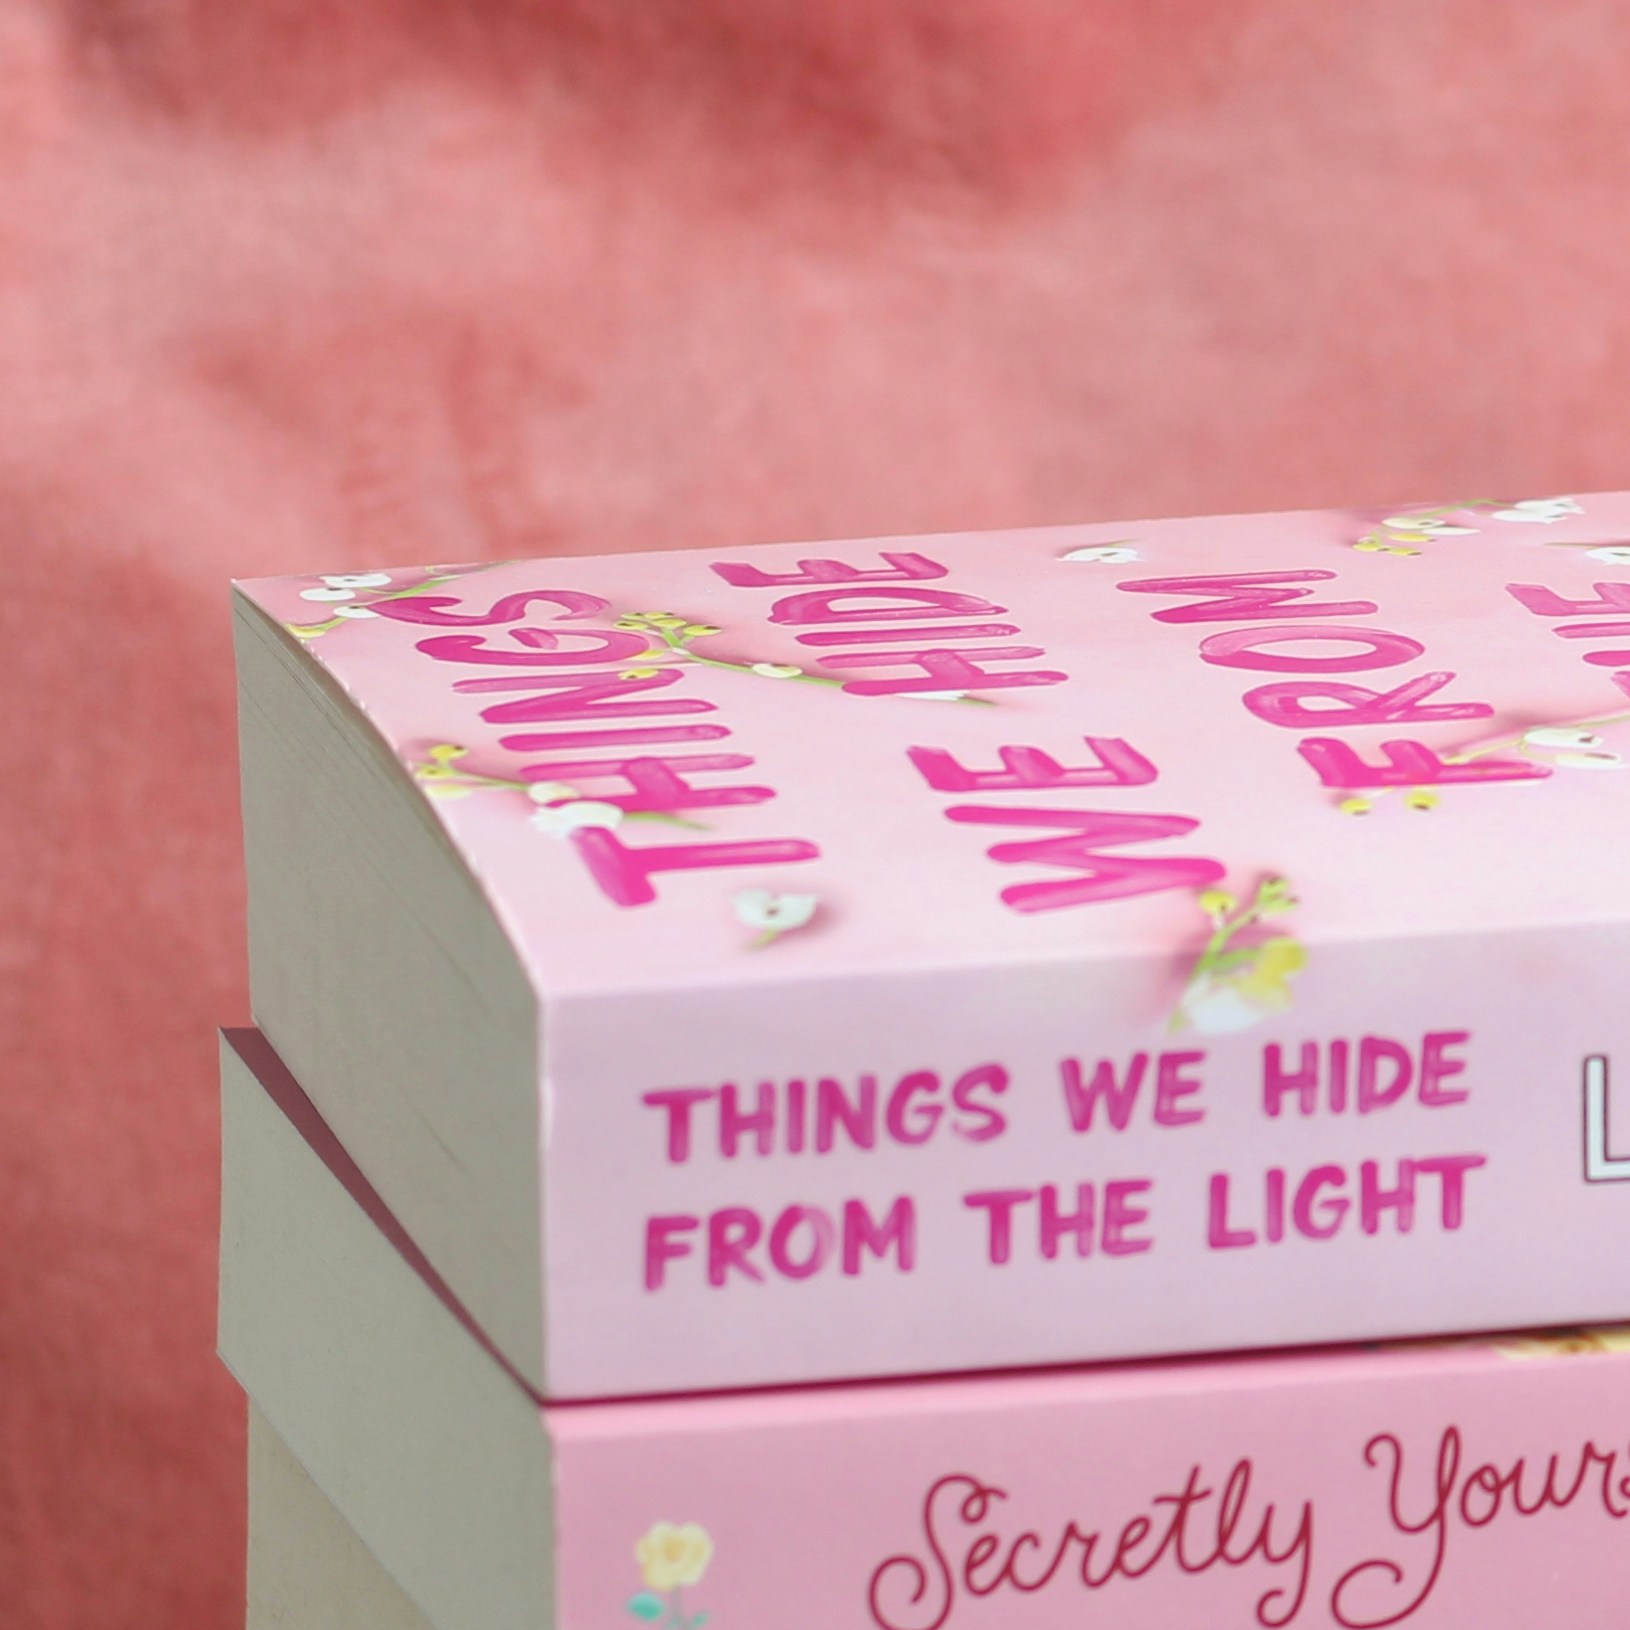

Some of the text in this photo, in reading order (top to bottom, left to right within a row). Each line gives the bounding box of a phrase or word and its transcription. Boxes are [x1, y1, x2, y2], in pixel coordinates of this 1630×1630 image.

[367, 587, 822, 908] THINGS
[710, 550, 1226, 916] WE HIDE
[1115, 568, 1553, 792] FROM
[642, 1030, 1472, 1163] THINGS WE HIDE
[644, 1154, 1488, 1292] FROM THE LIGHT
